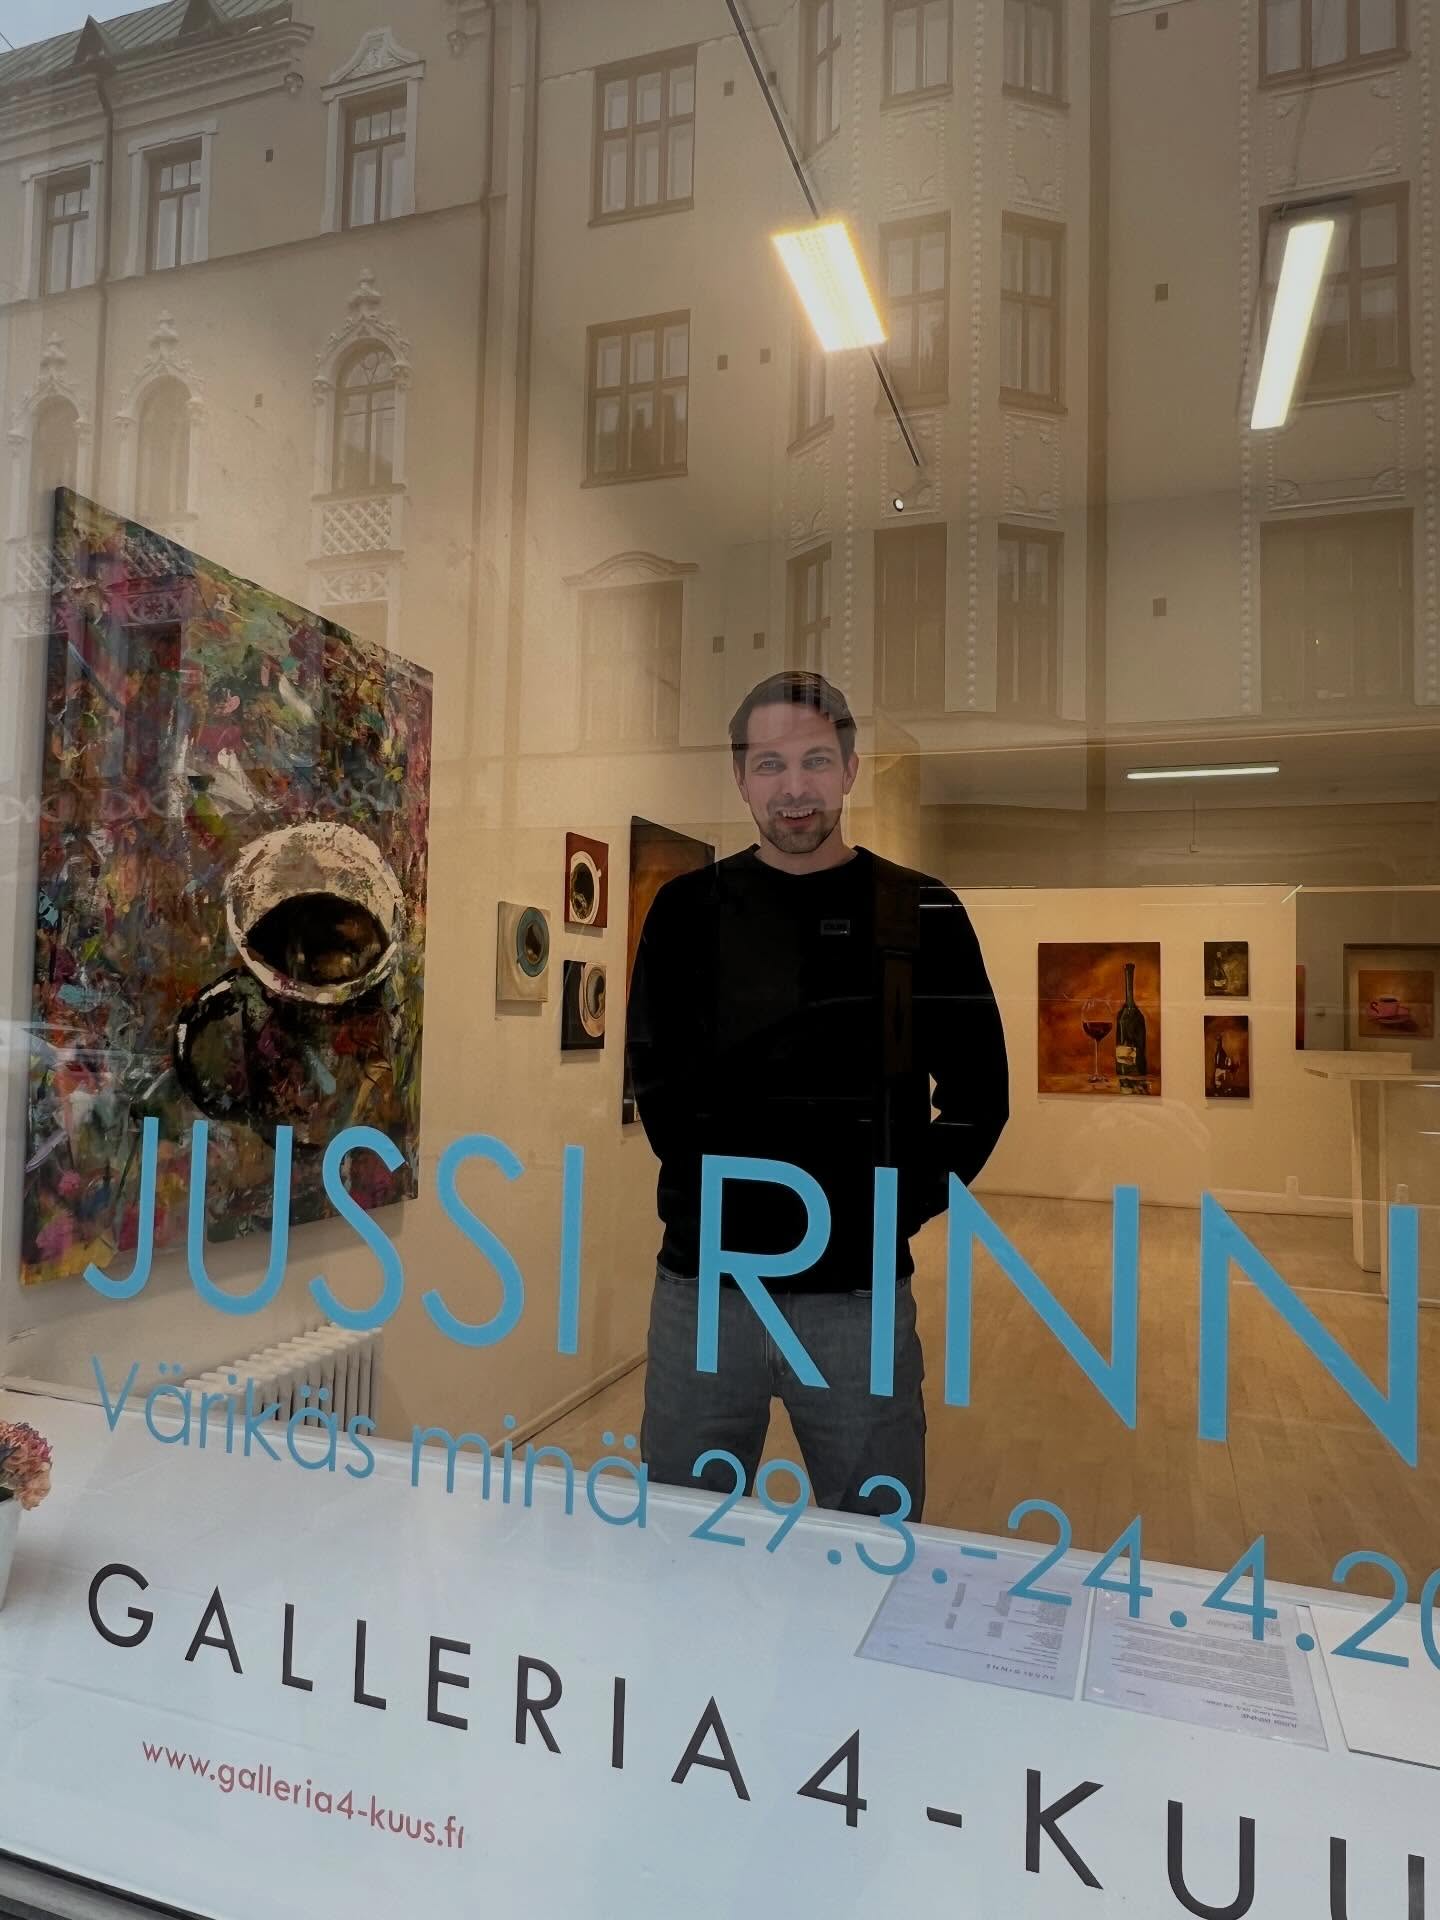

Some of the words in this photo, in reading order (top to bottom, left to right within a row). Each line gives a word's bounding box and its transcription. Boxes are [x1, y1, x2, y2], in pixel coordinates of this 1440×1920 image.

[83, 1116, 585, 1354] JUSSI
[696, 1154, 1418, 1468] RINN
[91, 1356, 376, 1479] Värikäs
[411, 1414, 649, 1529] minä
[690, 1449, 1440, 1670] 29.3.-24.4.2
[141, 1740, 465, 1849] www.galleria4-kuus.fi
